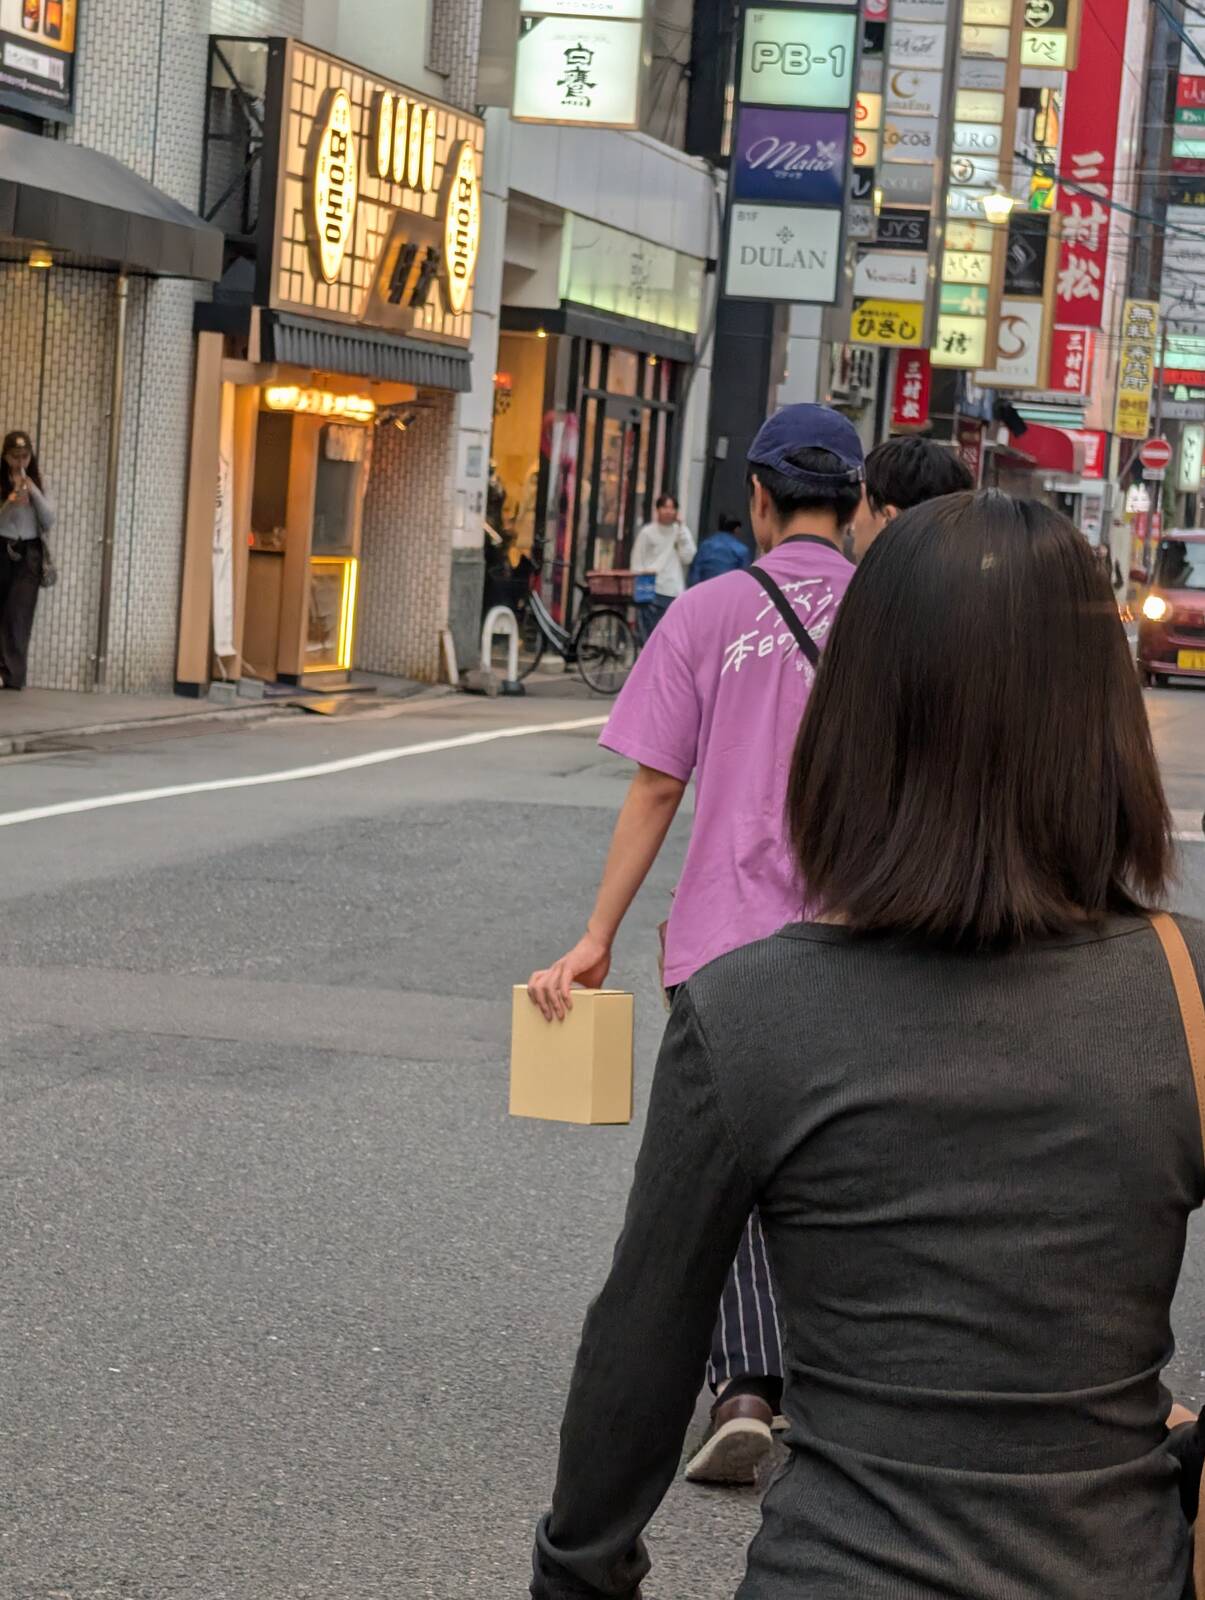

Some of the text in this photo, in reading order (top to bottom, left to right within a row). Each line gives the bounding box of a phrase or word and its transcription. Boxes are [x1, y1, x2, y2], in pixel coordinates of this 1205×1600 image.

[751, 41, 846, 78] PB-1
[1056, 150, 1108, 302] 三村松
[740, 245, 828, 269] DULAN
[858, 317, 917, 341] ひさし
